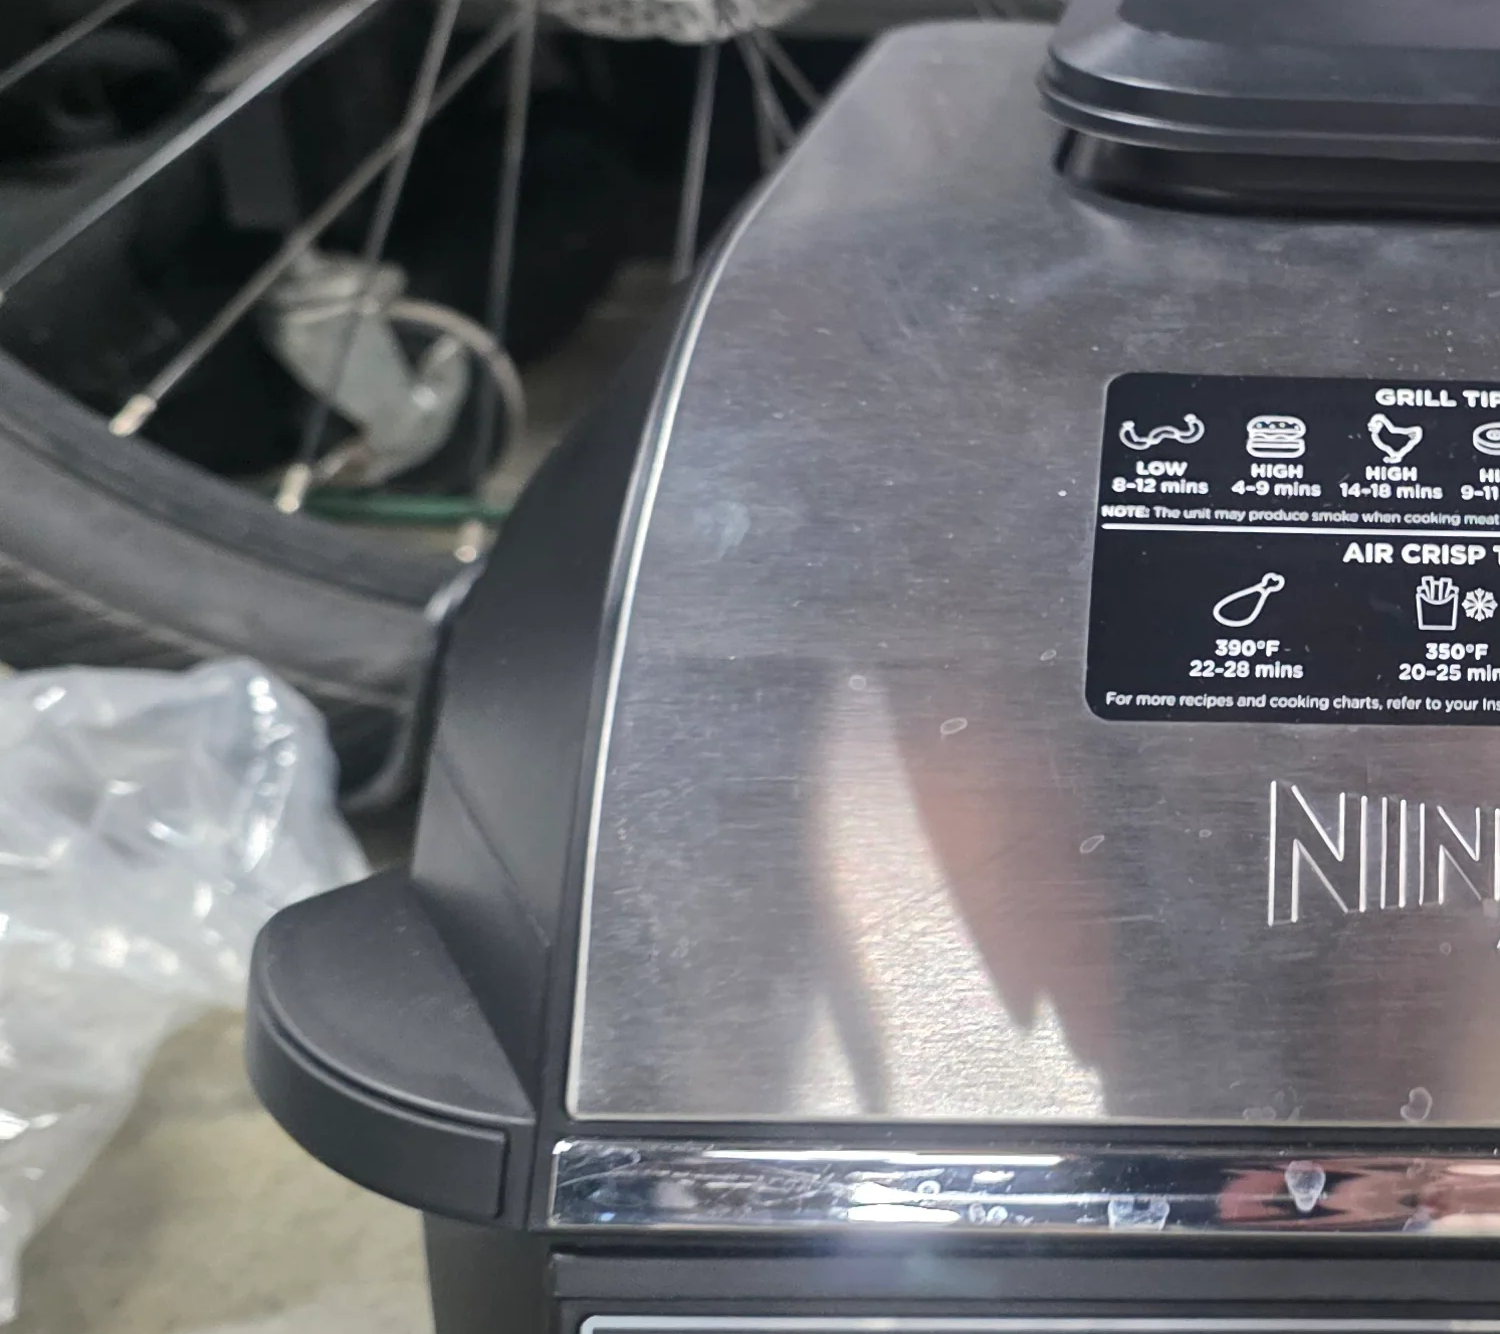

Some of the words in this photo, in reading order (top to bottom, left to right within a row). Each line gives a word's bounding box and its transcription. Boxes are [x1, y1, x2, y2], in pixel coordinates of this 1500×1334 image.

[1375, 388, 1457, 407] GRILL
[1136, 460, 1188, 477] LOW
[1250, 463, 1304, 479] HIGH
[1365, 465, 1417, 482] HIGH
[1111, 477, 1156, 493] 8-12
[1161, 478, 1209, 495] mins
[1231, 479, 1270, 496] 4-9
[1274, 480, 1322, 497] mins
[1339, 482, 1392, 499] 14-18
[1396, 483, 1444, 500] mins
[1461, 485, 1500, 502] 9-11
[1101, 505, 1150, 518] NOTE:
[1153, 506, 1180, 519] The
[1183, 508, 1211, 520] unit
[1214, 510, 1246, 522] may
[1249, 508, 1309, 522] produce
[1311, 510, 1359, 523] smoke
[1362, 511, 1401, 524] when
[1404, 512, 1461, 526] cooking
[1342, 542, 1393, 564] AIR
[1401, 543, 1486, 565] CRISP
[1215, 639, 1280, 657] 390°F
[1425, 642, 1489, 661] 350°F
[1188, 660, 1250, 678] 22-28
[1254, 660, 1304, 679] mins
[1399, 663, 1461, 682] 20-25
[1106, 691, 1133, 706] For
[1136, 694, 1176, 707] more
[1179, 693, 1234, 709] recipes
[1237, 694, 1267, 708] and
[1269, 695, 1329, 711] cooking
[1333, 695, 1383, 711] charts,
[1386, 696, 1422, 710] refer
[1425, 697, 1442, 711] to
[1445, 698, 1479, 713] your
